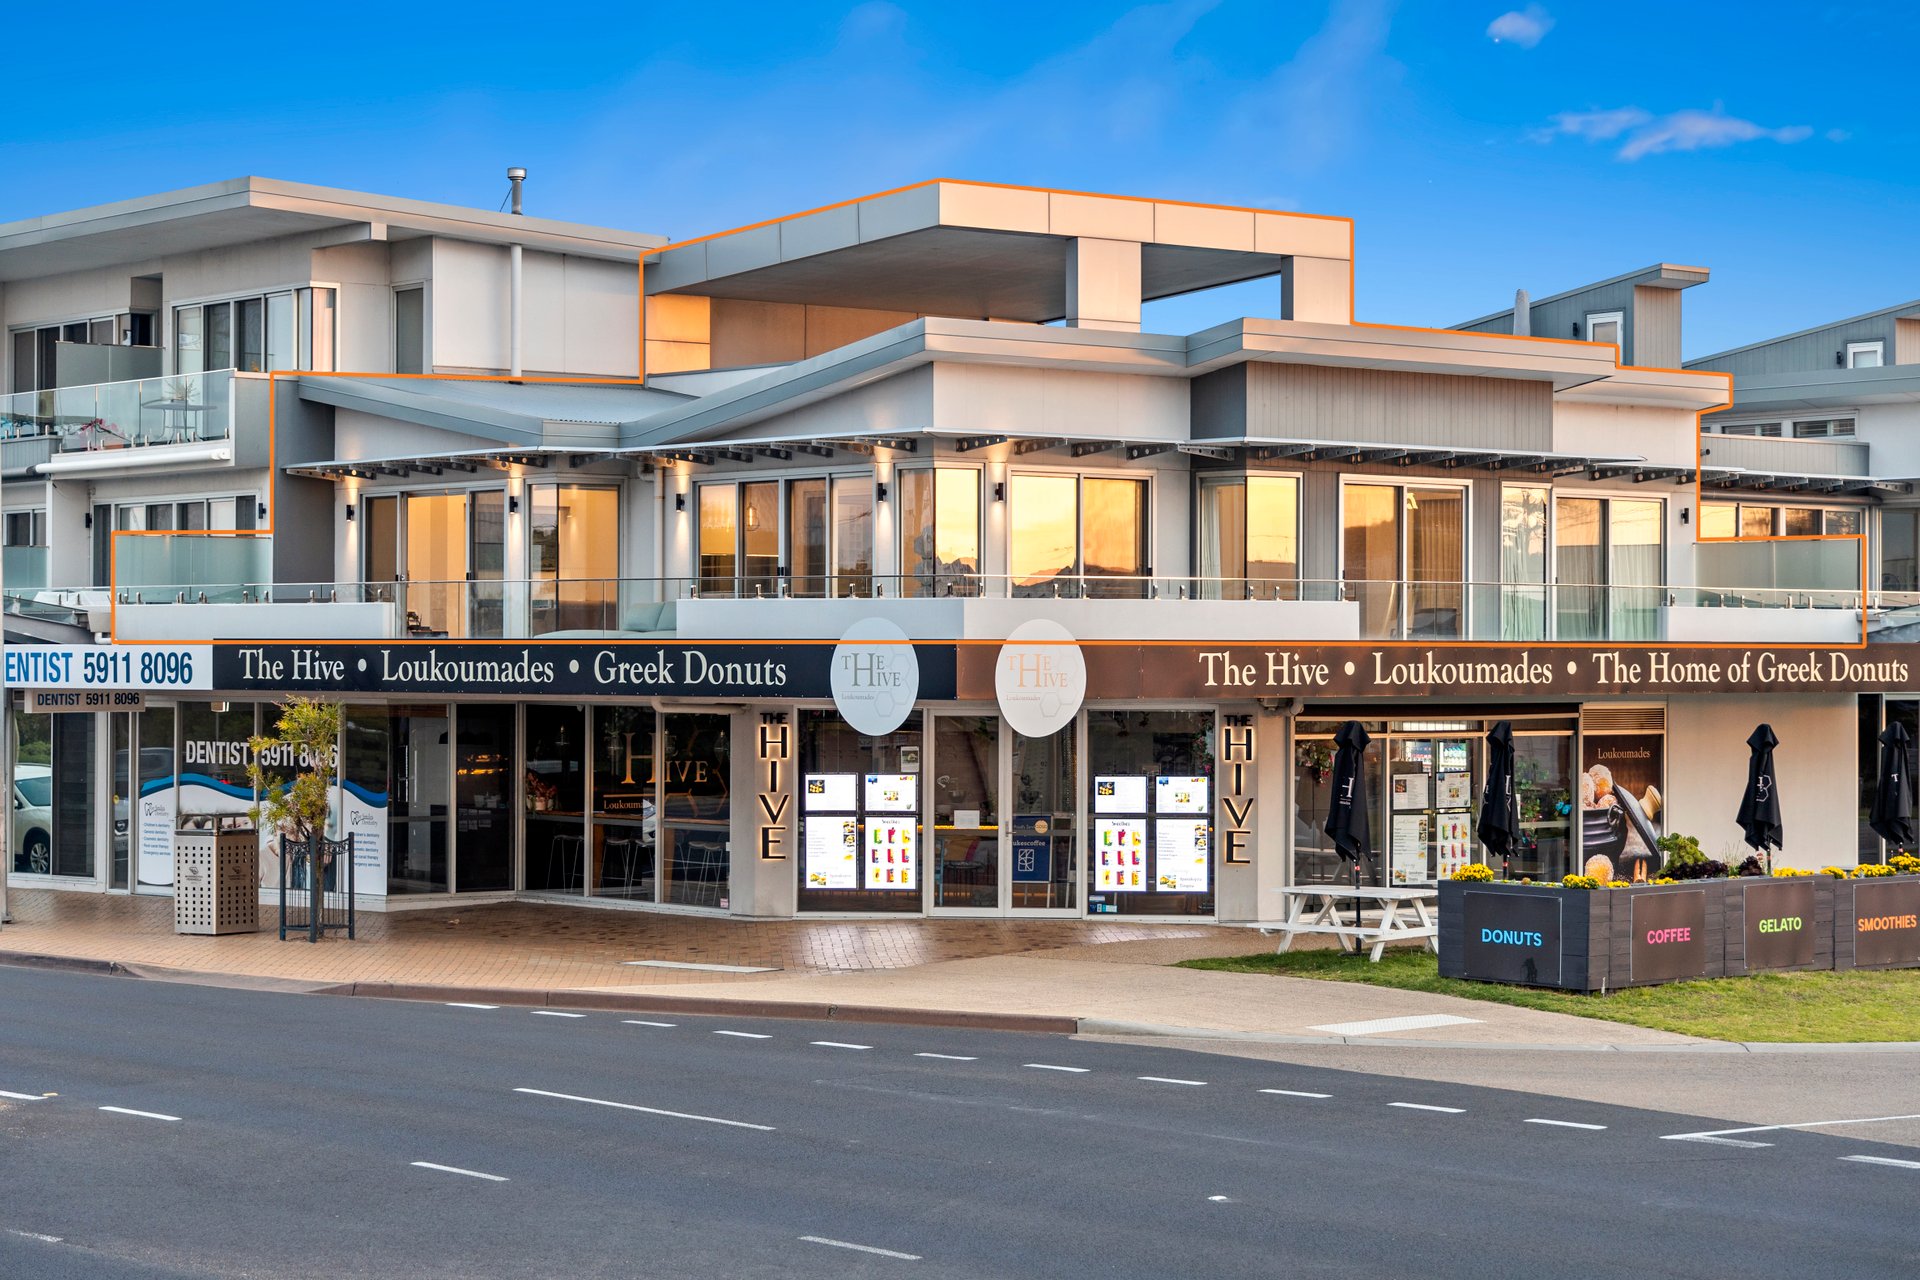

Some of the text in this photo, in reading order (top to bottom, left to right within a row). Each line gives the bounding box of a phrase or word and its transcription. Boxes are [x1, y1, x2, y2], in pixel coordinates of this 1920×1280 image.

[5, 652, 192, 684] ENTIST 5911 8096
[239, 647, 786, 685] The Hive Loukoumades Greek Donuts
[1199, 650, 1908, 686] The Hive Loukoumades The Home of Greek Donuts
[37, 692, 140, 706] DENTIST 5911 8096
[760, 712, 788, 724] THE
[1224, 714, 1253, 727] THE
[186, 740, 250, 766] DENTIST
[261, 743, 295, 767] 5911
[1598, 747, 1650, 759] Loukoumades
[758, 726, 789, 860] HIVE
[1223, 728, 1254, 864] HIVE
[1758, 917, 1802, 933] GELATO
[1857, 914, 1918, 932] SMOOTHIES
[1481, 928, 1543, 947] DONUTS
[1647, 927, 1691, 945] COFFEE
